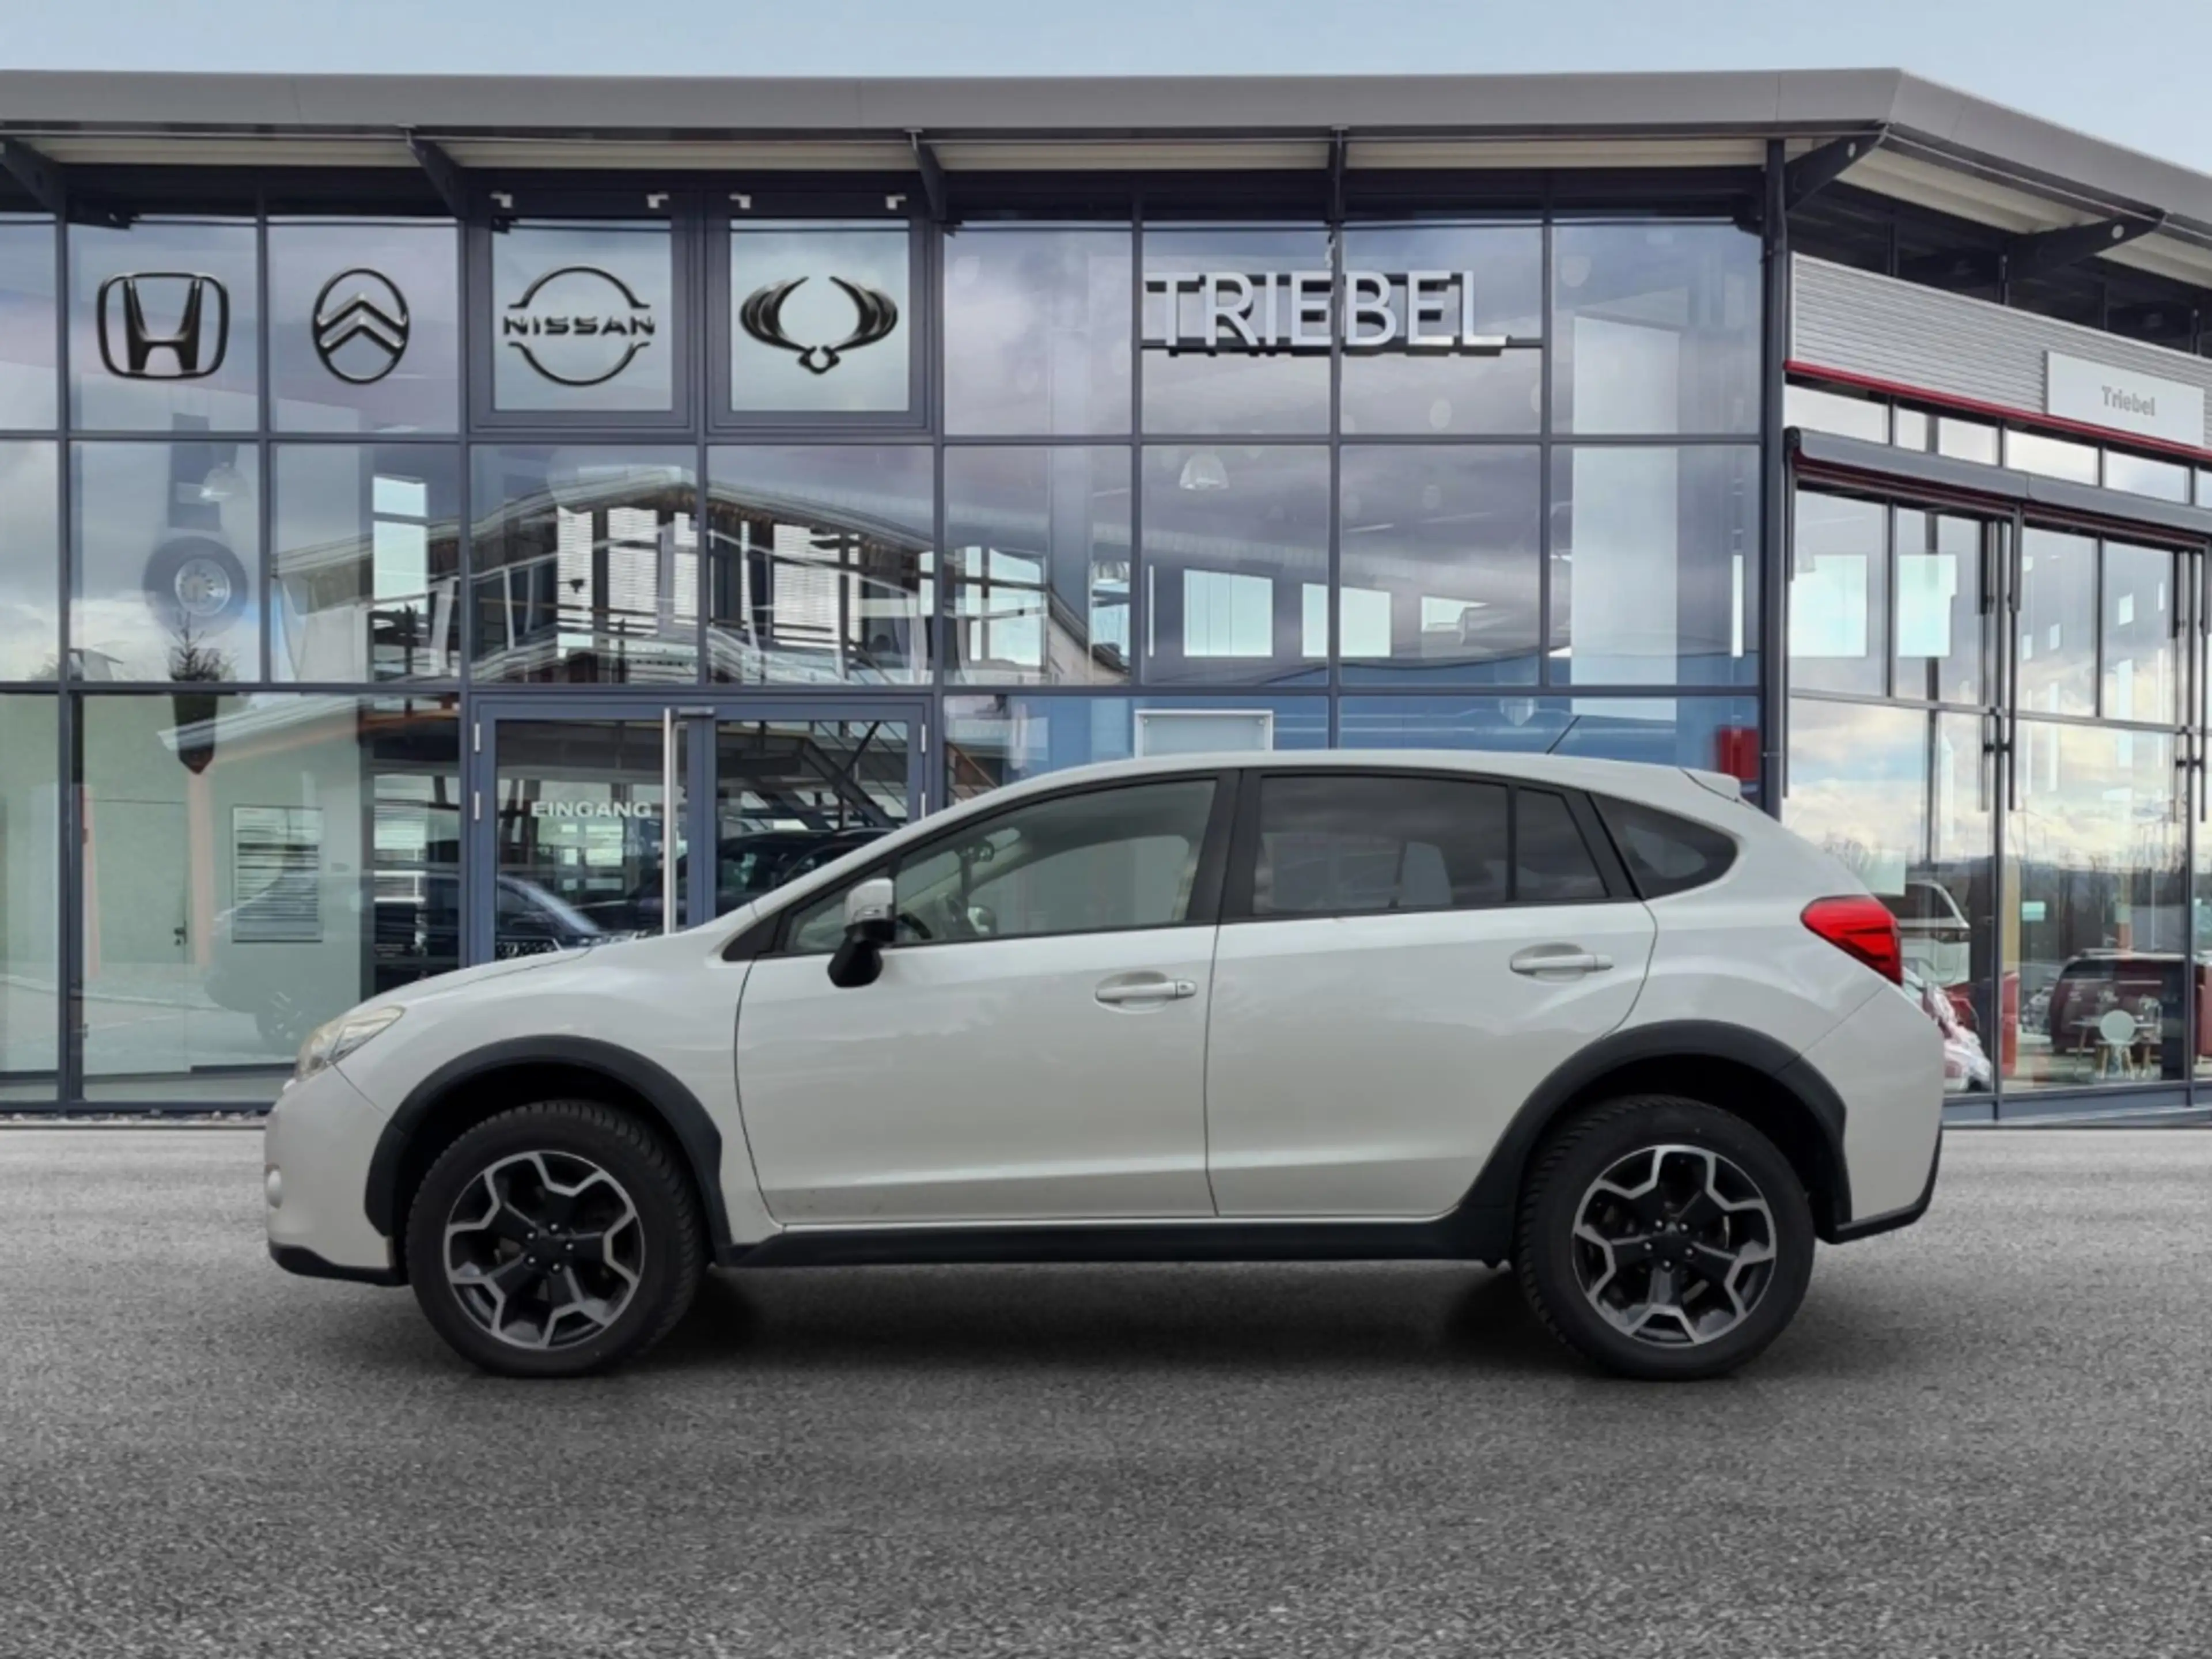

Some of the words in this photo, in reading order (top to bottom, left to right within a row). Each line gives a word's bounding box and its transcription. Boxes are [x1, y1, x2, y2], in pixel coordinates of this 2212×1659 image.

[1144, 270, 1508, 347] TRIEBEL
[503, 316, 656, 336] NISSAN
[2101, 384, 2155, 417] Triebel
[531, 801, 652, 818] EINGANG
